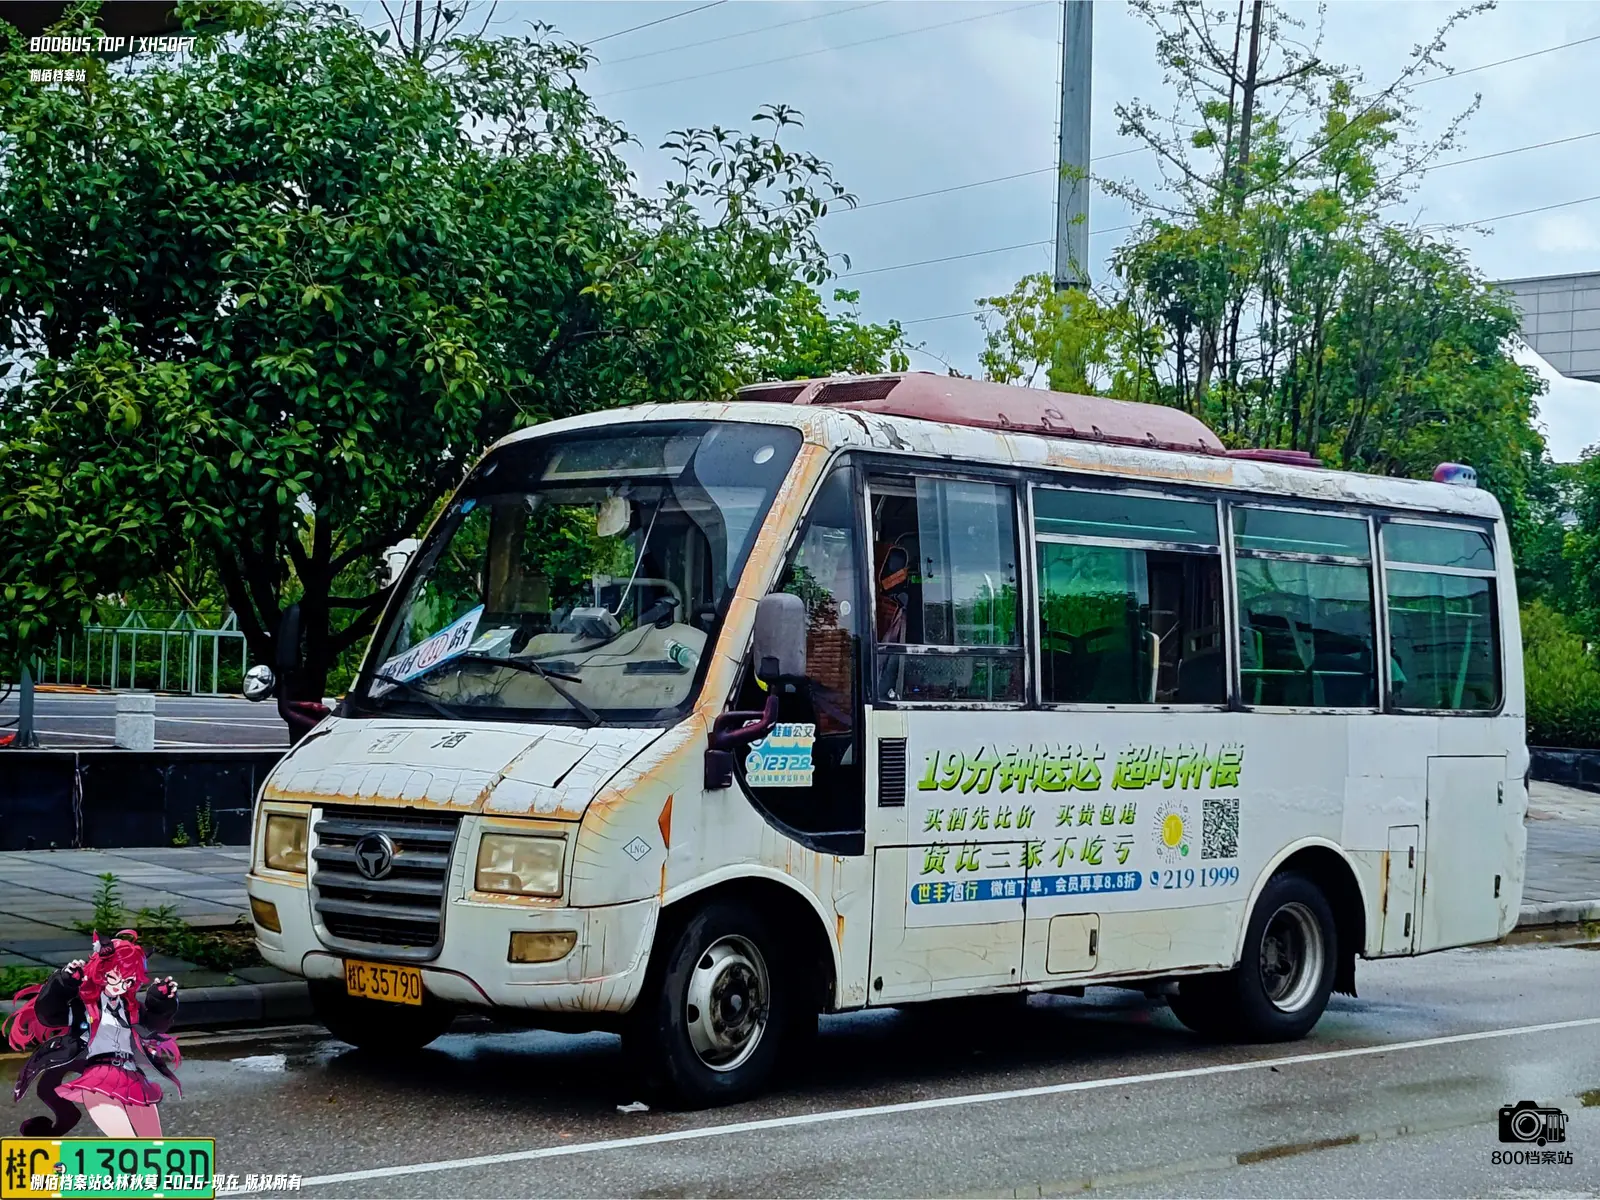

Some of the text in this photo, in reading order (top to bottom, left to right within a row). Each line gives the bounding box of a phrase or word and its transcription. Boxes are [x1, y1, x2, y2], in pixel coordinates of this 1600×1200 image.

[762, 756, 813, 771] 12328
[917, 743, 1245, 795] 19分钟送达 超时补偿
[922, 801, 1138, 832] 买酒先比价 买贵包退
[630, 844, 645, 854] LNG
[1163, 865, 1240, 889] 219 1999
